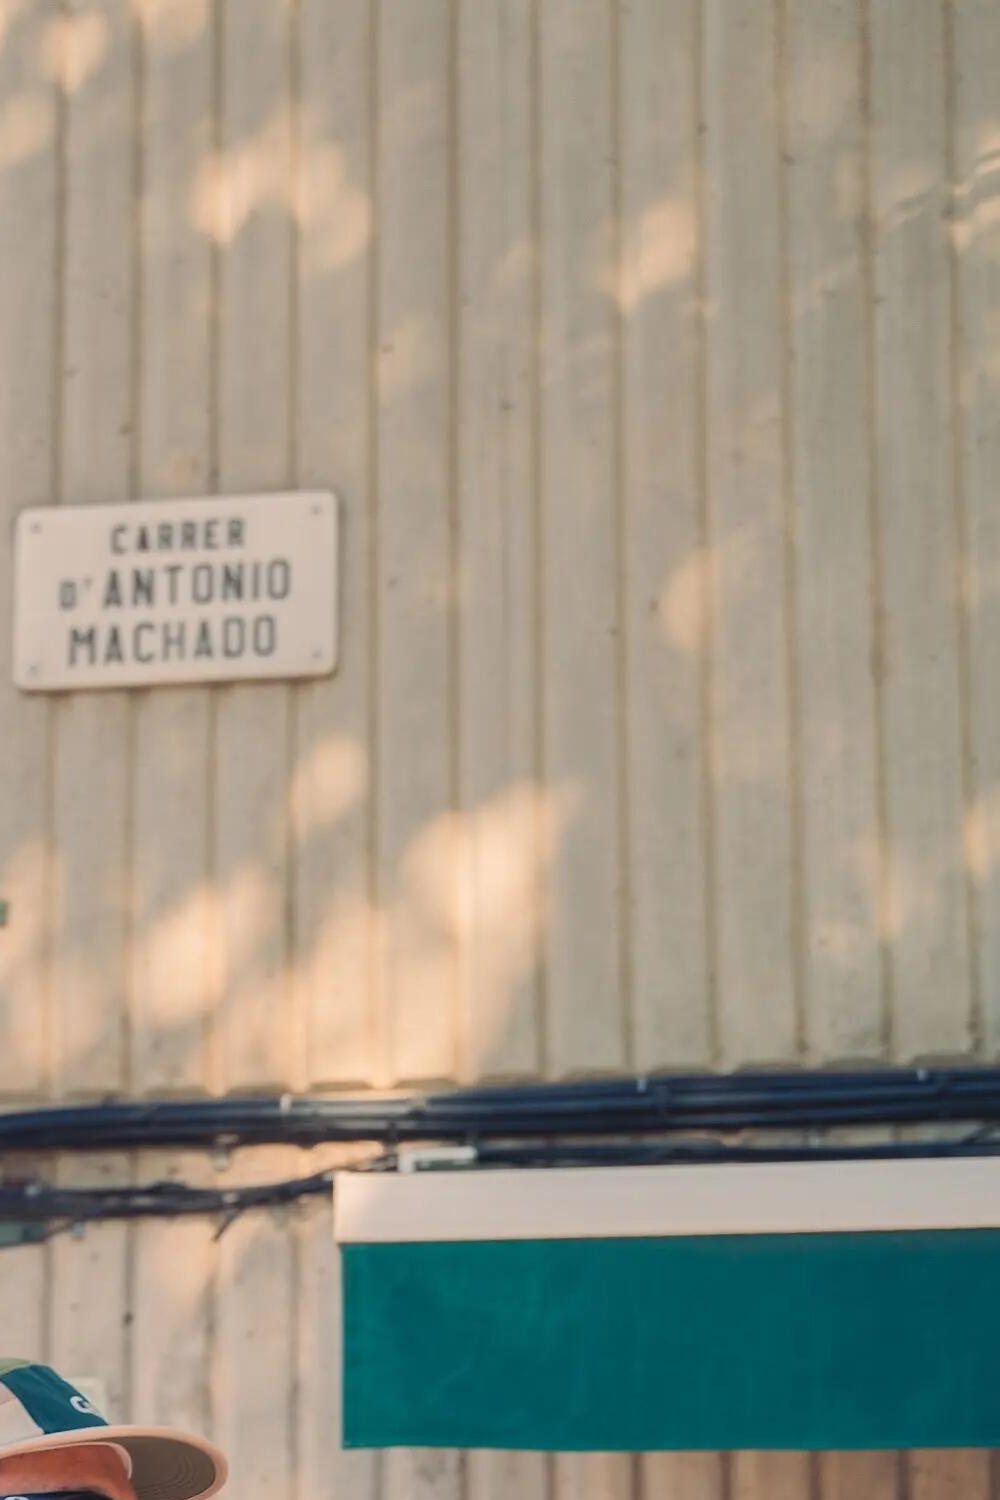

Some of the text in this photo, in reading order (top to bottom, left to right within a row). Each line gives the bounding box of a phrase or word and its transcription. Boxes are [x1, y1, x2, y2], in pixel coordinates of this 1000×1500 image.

[109, 517, 247, 555] CARRER
[57, 557, 293, 612] D'ANTONIO
[67, 614, 277, 668] MACHADO
